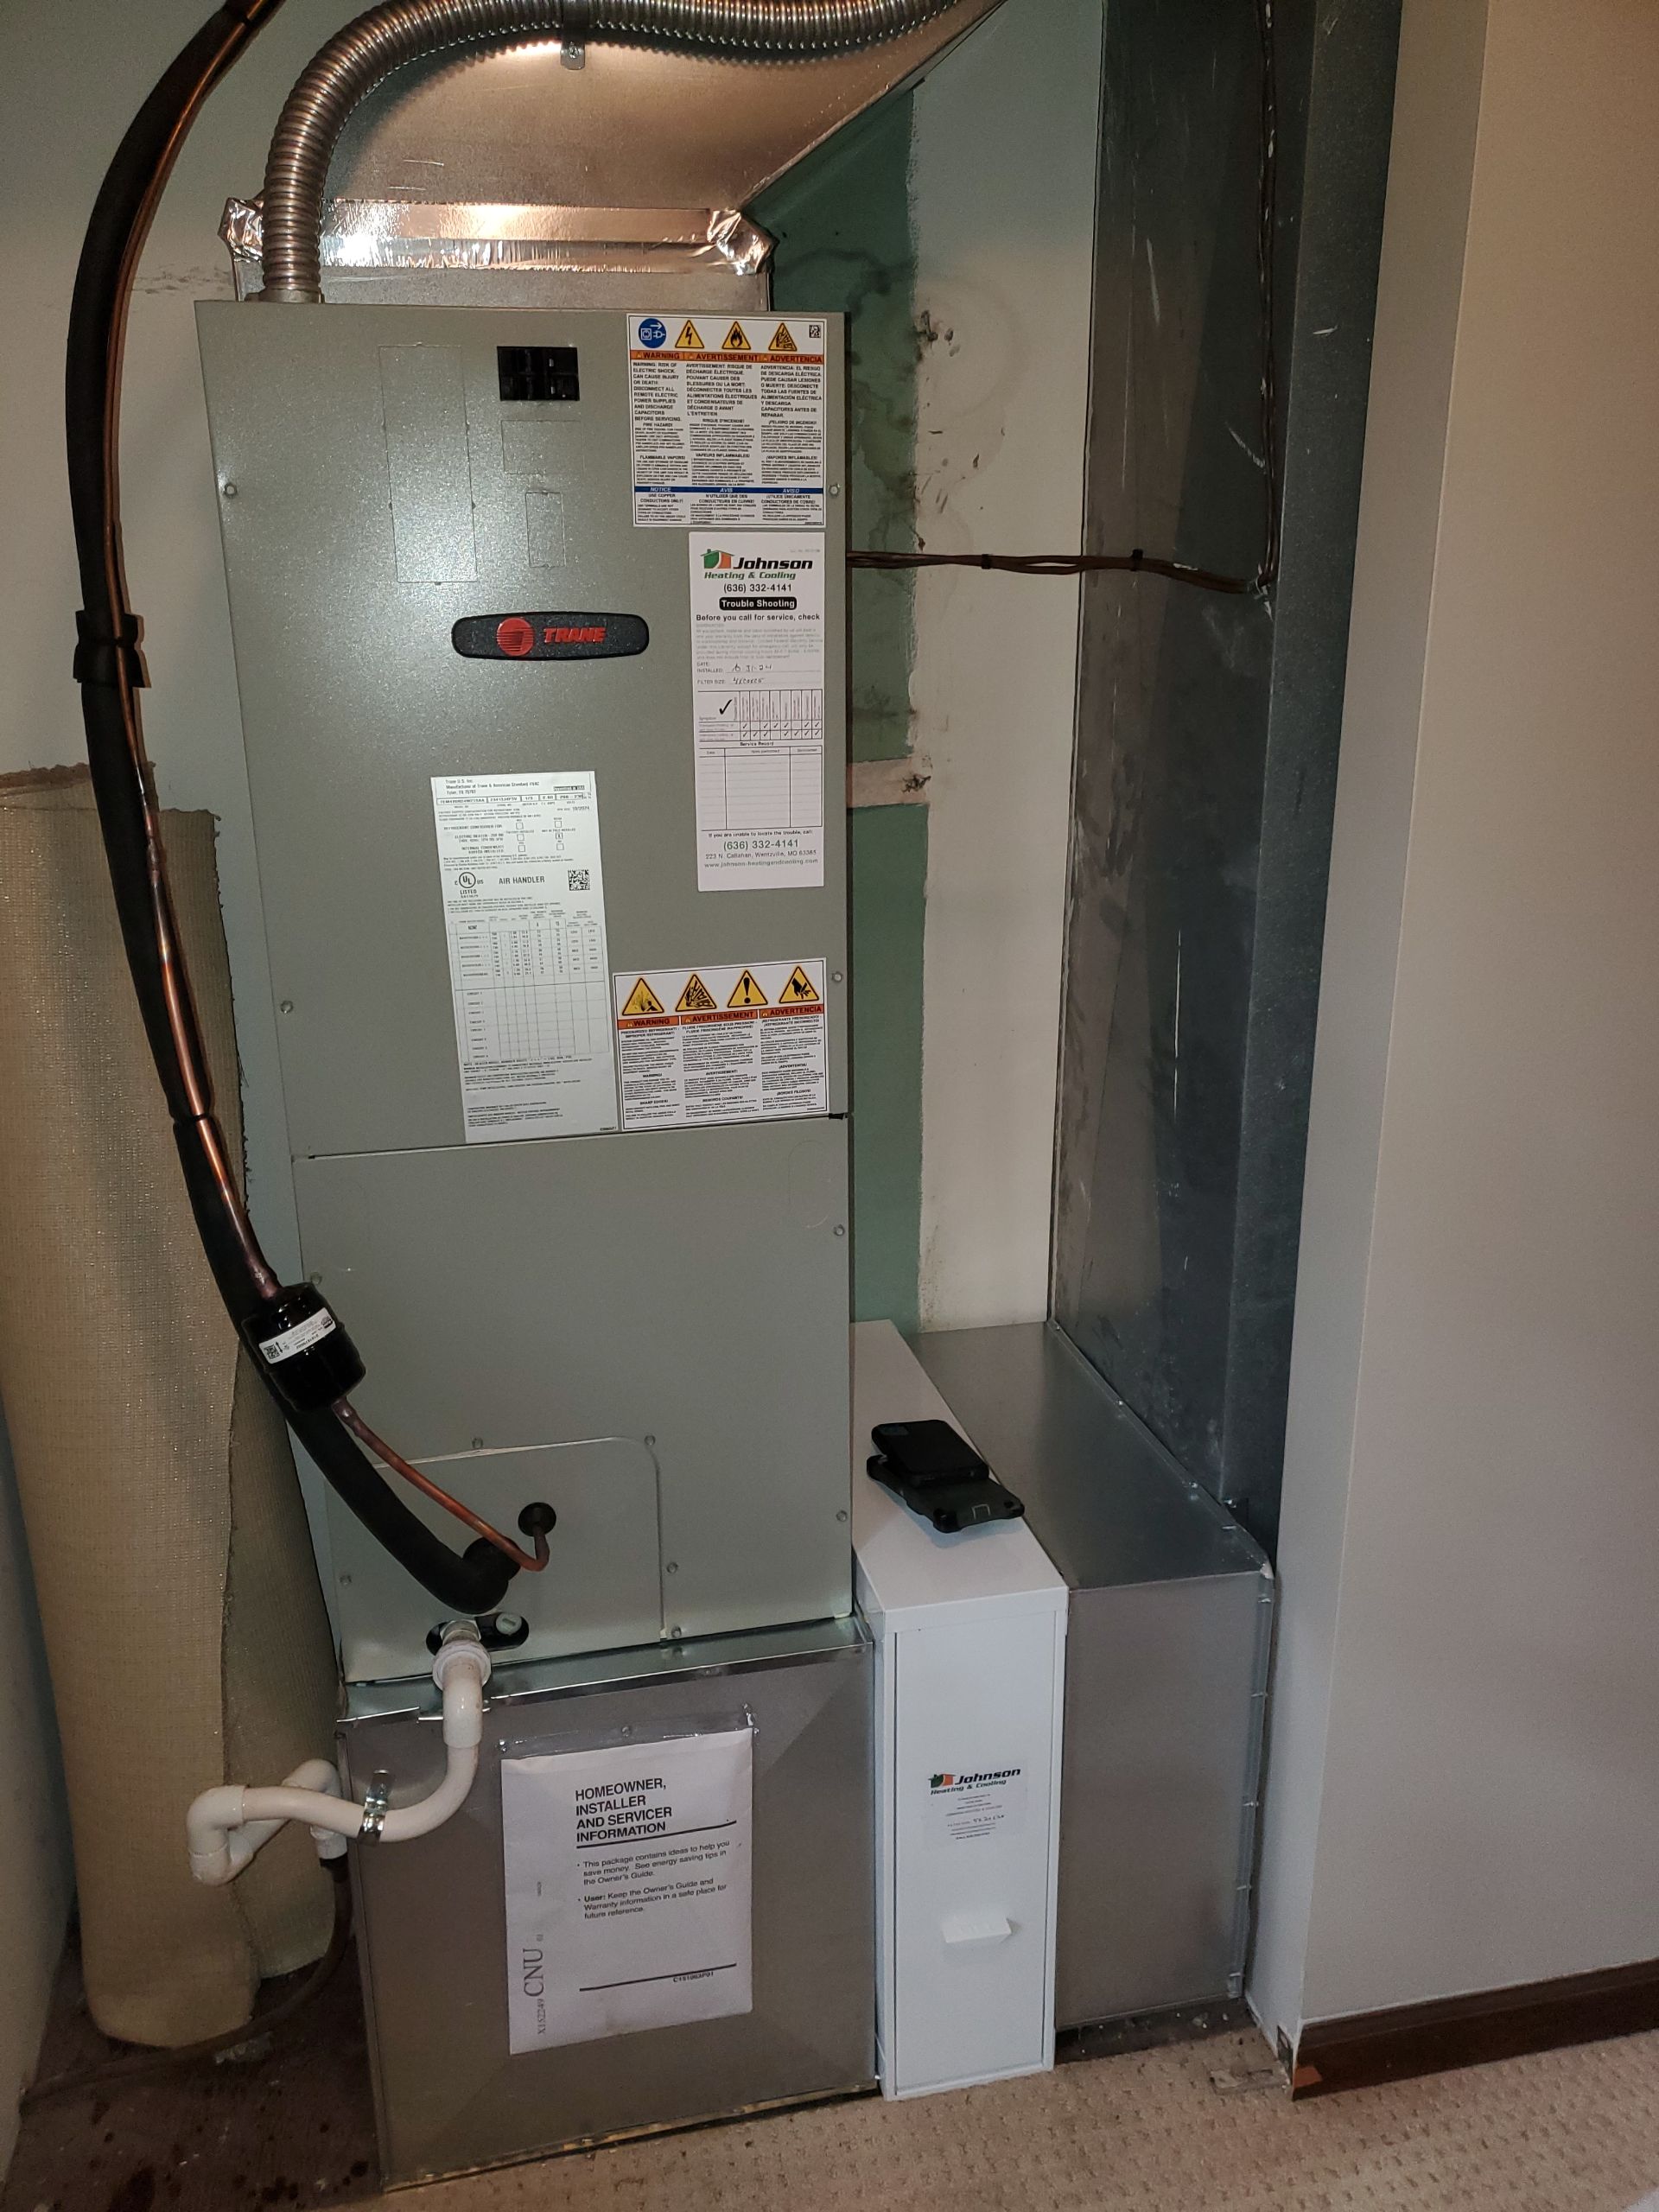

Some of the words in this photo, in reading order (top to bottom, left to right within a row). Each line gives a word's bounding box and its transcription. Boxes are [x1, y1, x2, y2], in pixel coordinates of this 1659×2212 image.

[696, 353, 758, 362] AVERTISSEMENT
[770, 355, 822, 363] ADVERTENCIA
[733, 557, 813, 570] Johnson
[704, 572, 744, 580] Heating
[748, 572, 754, 580] &
[759, 572, 796, 580] Cooling
[724, 584, 746, 593] (636)
[750, 583, 791, 593] 332-4141
[721, 600, 753, 608] Trouble
[757, 600, 795, 608] Shooting
[696, 614, 720, 622] Before
[723, 614, 736, 622] you
[739, 614, 751, 622] call
[754, 614, 764, 622] for
[798, 614, 820, 622] check
[543, 628, 606, 643] TRANE
[724, 840, 747, 851] (636)
[752, 838, 799, 850] 332-4141
[499, 876, 510, 884] AIR
[513, 875, 545, 884] HANDLER
[693, 1011, 753, 1022] AVERTISSEMENT
[770, 1006, 821, 1016] ADVERTENCIA
[633, 1018, 670, 1027] WARNING
[955, 1768, 1021, 1785] Johnson
[575, 1777, 666, 1802] HOMEOWNER,
[576, 1795, 646, 1816] INSTALLER
[577, 1816, 604, 1830] AND
[608, 1806, 672, 1826] SERVICER
[577, 1821, 666, 1843] INFORMATION
[583, 1859, 599, 1868] This
[601, 1854, 633, 1866] package
[635, 1849, 666, 1861] contains
[668, 1846, 687, 1856] ideas
[690, 1845, 697, 1853] to
[699, 1843, 714, 1852] help
[717, 1841, 730, 1850] you
[584, 1893, 605, 1903] User:
[523, 1948, 544, 1997] CNU
